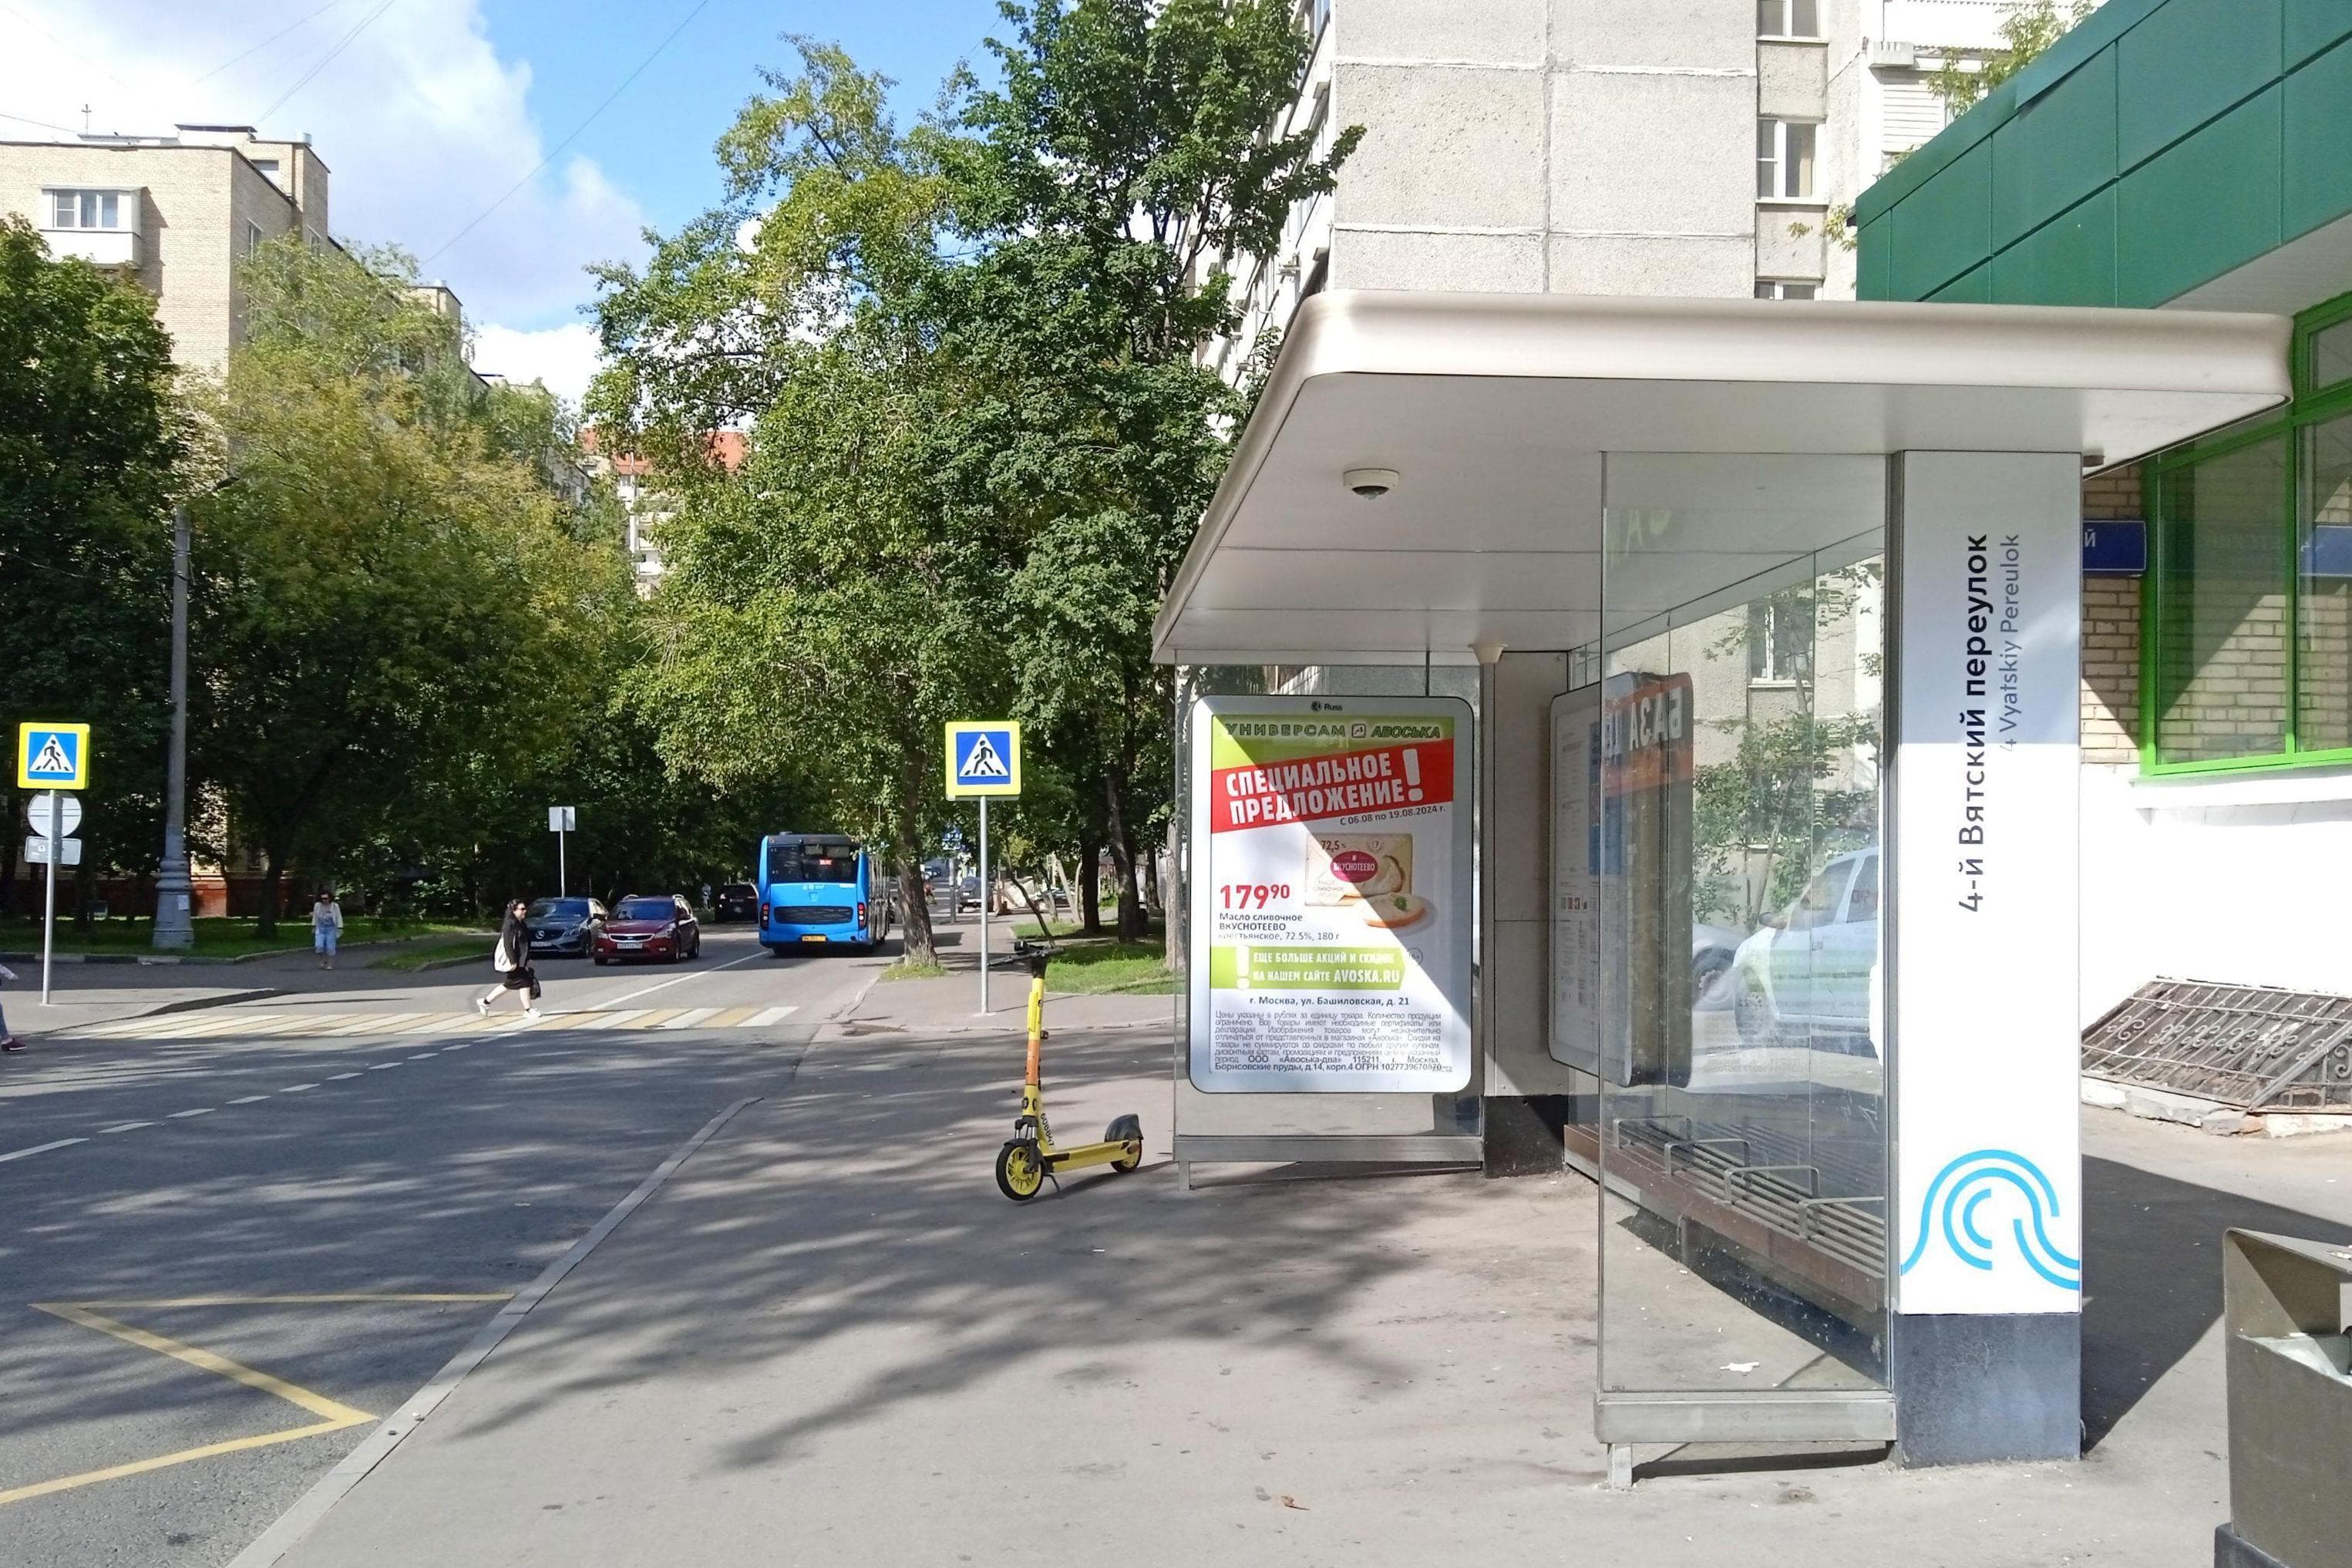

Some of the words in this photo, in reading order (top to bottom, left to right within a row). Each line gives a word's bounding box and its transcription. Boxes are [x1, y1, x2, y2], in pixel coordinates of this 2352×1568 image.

[2000, 533, 2021, 634] Pereulok
[1966, 533, 1994, 697] переулок
[1998, 641, 2023, 734] Vyatskiy
[1225, 723, 1346, 738] УНИВЕРСАМ
[1371, 725, 1442, 739] АВОСЬКА
[2000, 739, 2018, 752] 4
[1226, 752, 1392, 797] СПЕЦИАЛЬНОЕ
[1959, 708, 1987, 846] Вятский
[1230, 778, 1405, 825] ПРЕДЛОЖЕНИЕ
[1348, 814, 1373, 826] 06.08
[1375, 814, 1387, 824] по
[1388, 806, 1437, 821] 19.08.2024
[1959, 858, 1984, 913] 4-й
[1219, 913, 1250, 921] Масло
[1317, 932, 1334, 940] 180
[1253, 952, 1273, 964] ЕЩЕ
[1275, 952, 1314, 964] БОЛЬШЕ
[1317, 951, 1347, 964] АКЦИЙ
[1350, 953, 1357, 964] И
[1267, 971, 1301, 982] НАШЕМ
[1303, 969, 1331, 982] САЙТЕ
[1333, 969, 1401, 984] AVOSKA.RU
[1258, 997, 1297, 1007] Москва,
[1300, 998, 1314, 1008] ул.
[1317, 996, 1385, 1007] Башиловская,
[1398, 997, 1409, 1006] 21
[1215, 1062, 1272, 1072] Борисовские
[1273, 1063, 1304, 1072] пруды,
[1354, 1062, 1379, 1071] ОГРН
